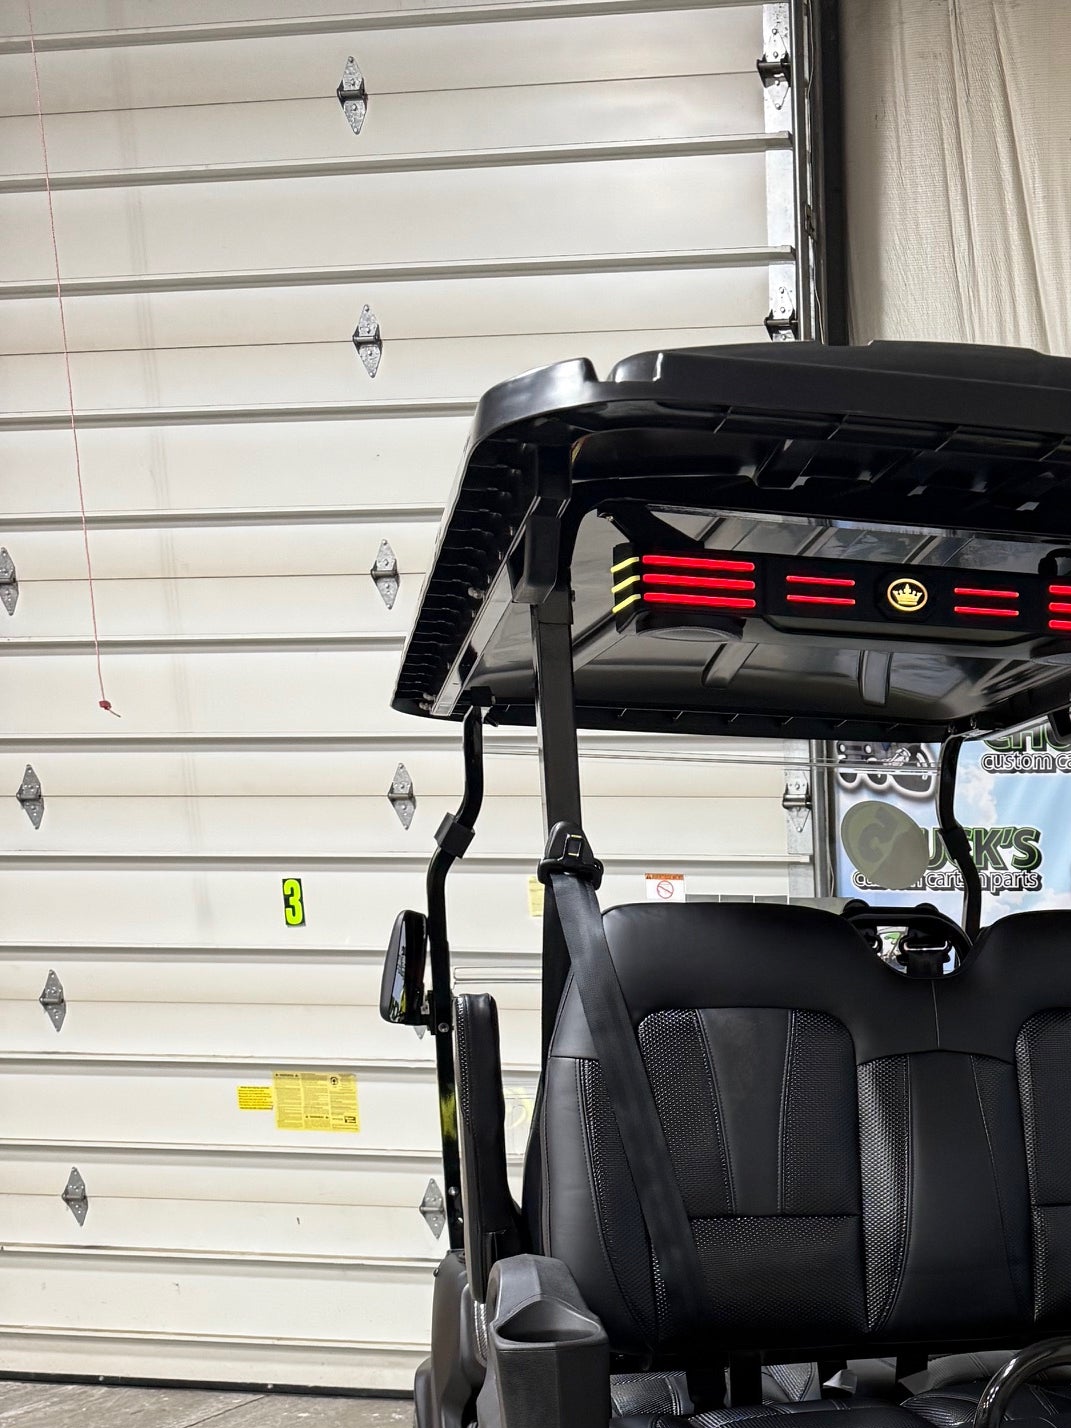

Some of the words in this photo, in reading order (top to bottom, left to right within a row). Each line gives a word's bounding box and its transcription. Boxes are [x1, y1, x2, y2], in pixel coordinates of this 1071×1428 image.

[982, 750, 1054, 772] custom
[990, 871, 1041, 894] parts
[284, 878, 304, 925] 3
